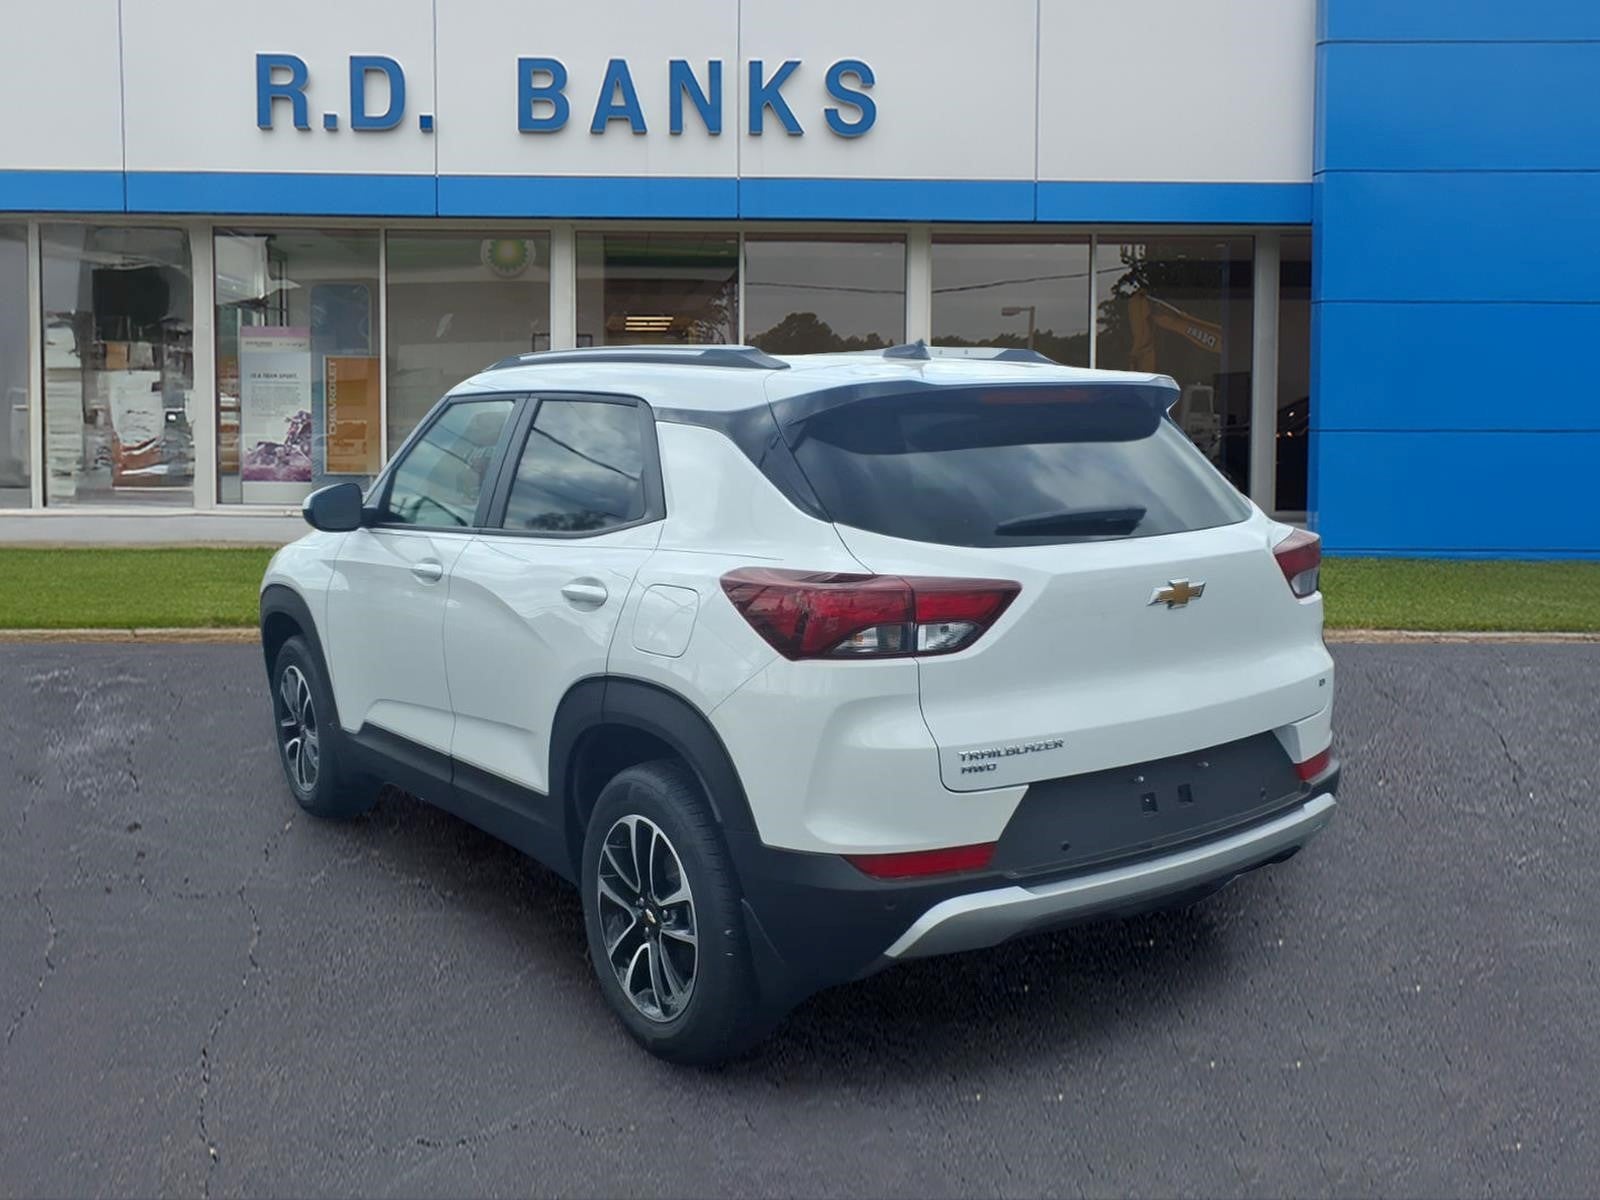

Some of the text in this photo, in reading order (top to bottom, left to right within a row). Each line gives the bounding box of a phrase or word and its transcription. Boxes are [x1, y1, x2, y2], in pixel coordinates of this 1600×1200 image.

[256, 53, 877, 138] R.D. BANKS
[958, 738, 1065, 762] TRAILBLAZER
